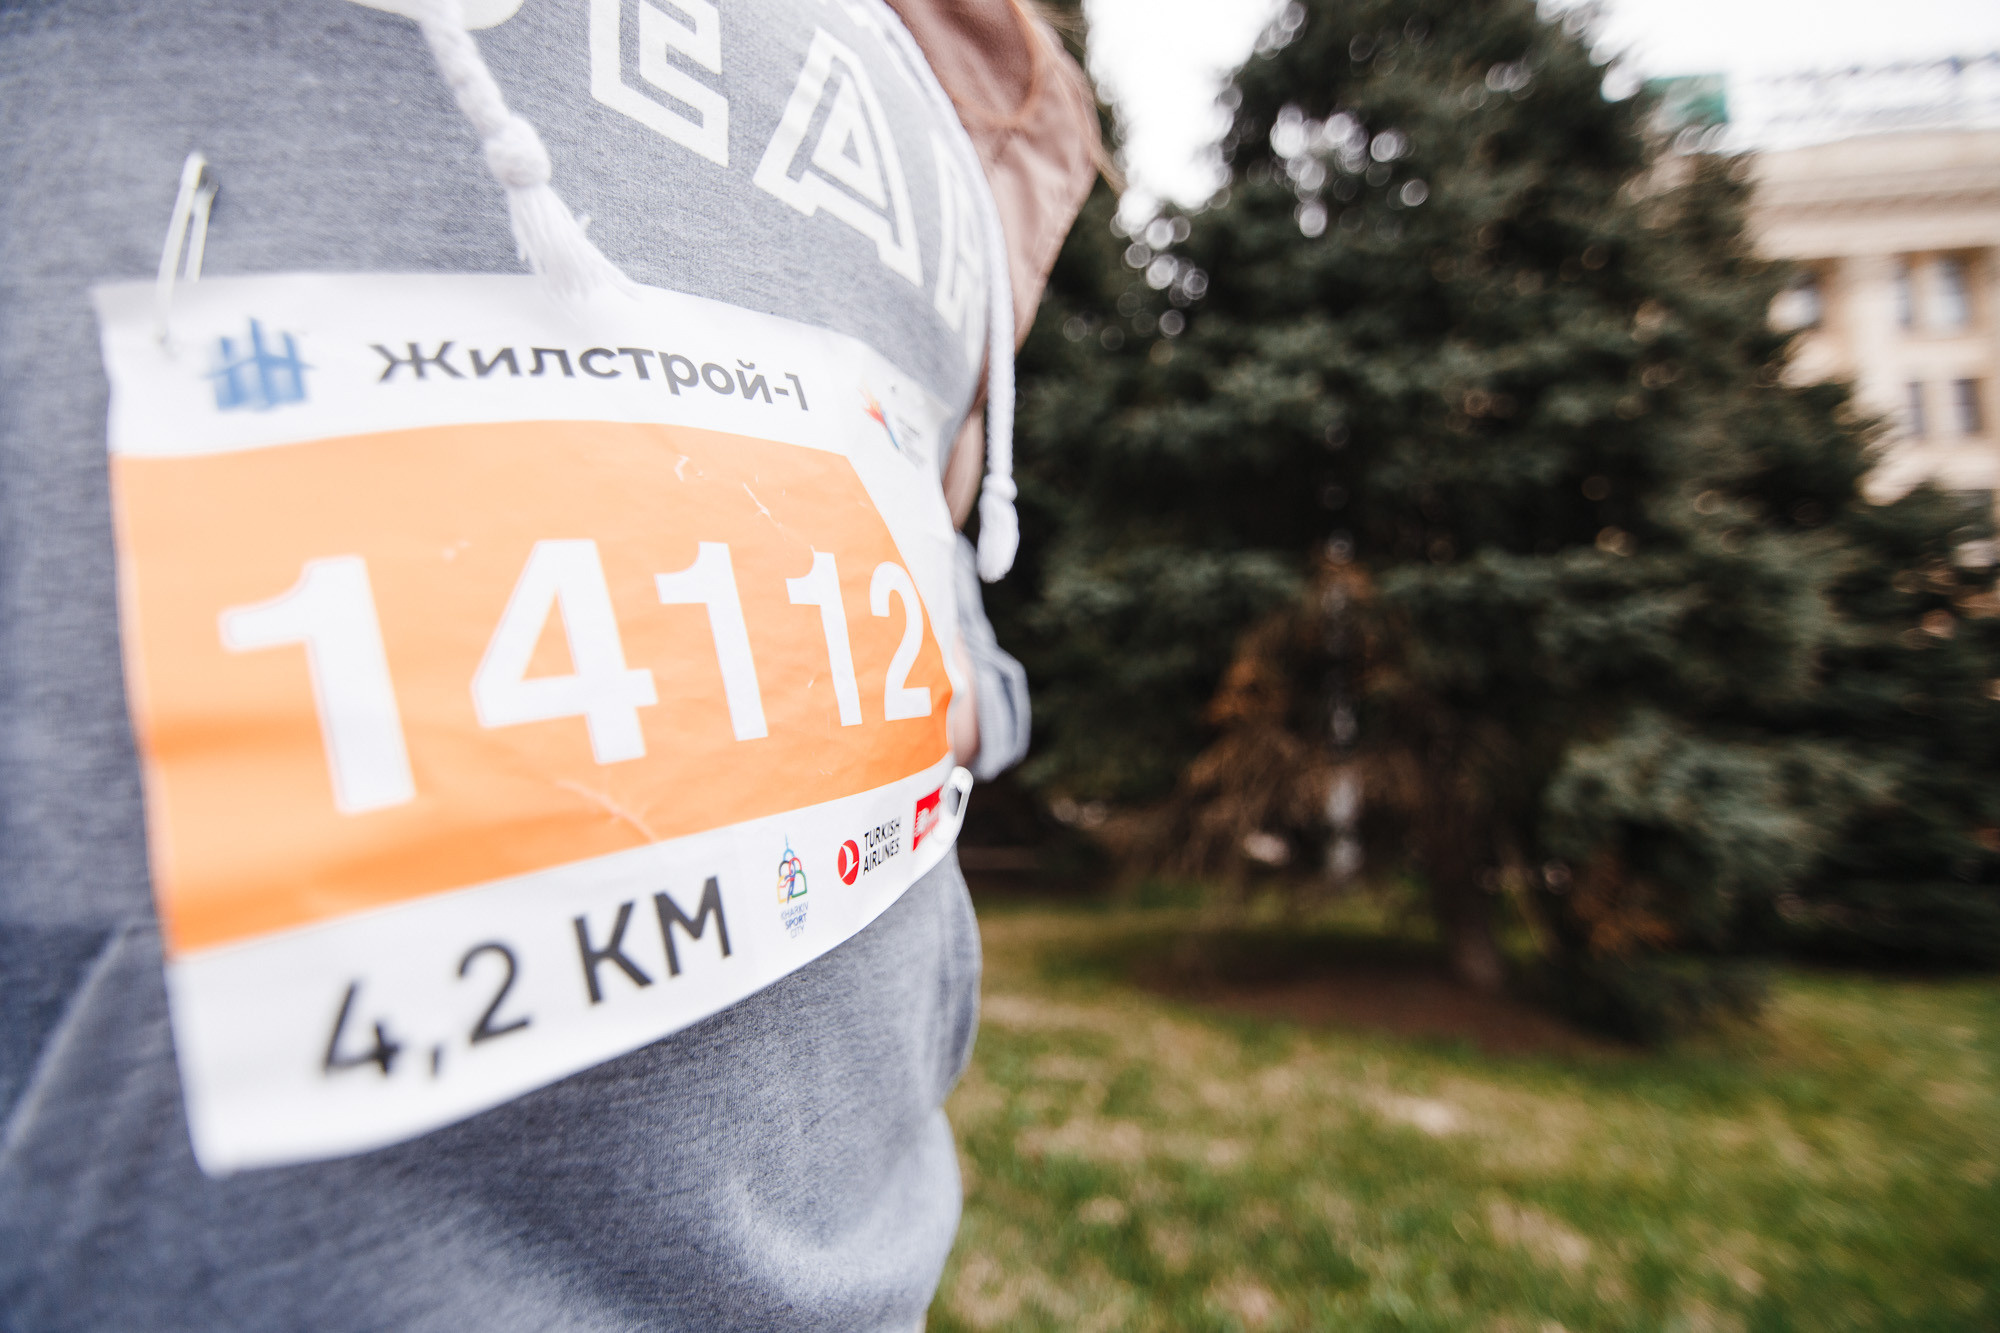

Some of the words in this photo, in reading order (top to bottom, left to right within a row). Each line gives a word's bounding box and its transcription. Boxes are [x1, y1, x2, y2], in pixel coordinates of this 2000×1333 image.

[367, 335, 810, 412] Жилстрой-1
[217, 537, 933, 817] 14112
[863, 838, 900, 875] AIRLINES
[864, 816, 901, 852] TURKISH
[785, 912, 807, 930] SPORT
[320, 940, 533, 1078] 4,2
